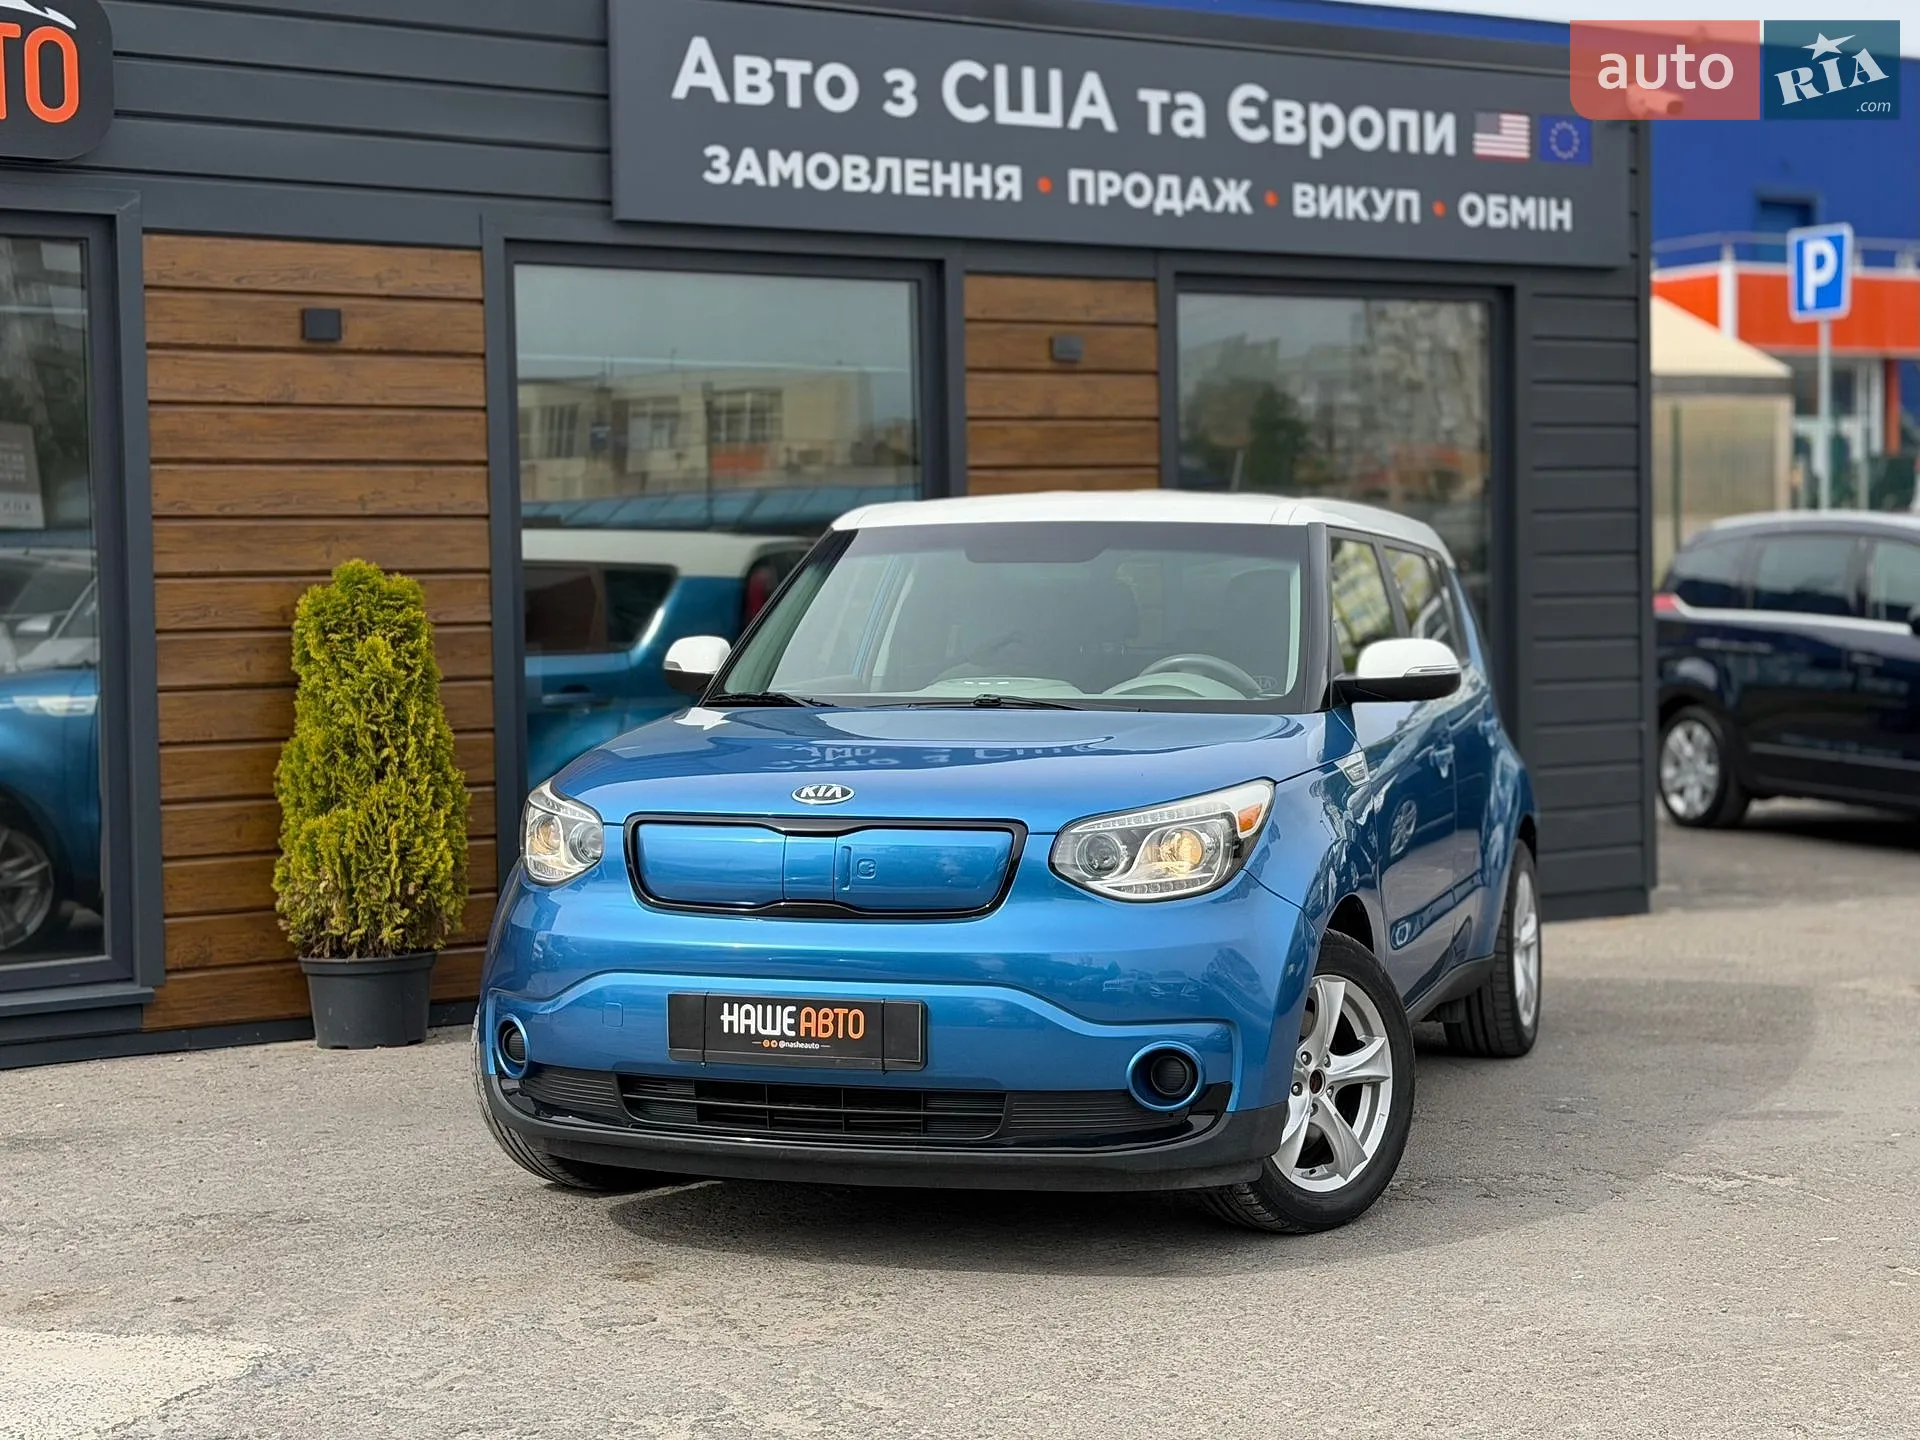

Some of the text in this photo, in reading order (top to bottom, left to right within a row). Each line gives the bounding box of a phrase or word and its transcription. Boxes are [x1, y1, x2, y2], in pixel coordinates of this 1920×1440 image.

[671, 36, 1457, 159] Авто з США та Європи
[702, 144, 1573, 231] ЗАМОВЛЕННЯ ПРОДАЖ ВИКУП ОБМІН
[1803, 238, 1839, 309] P
[800, 785, 842, 798] KIA
[778, 1040, 820, 1050] @nasheauto
